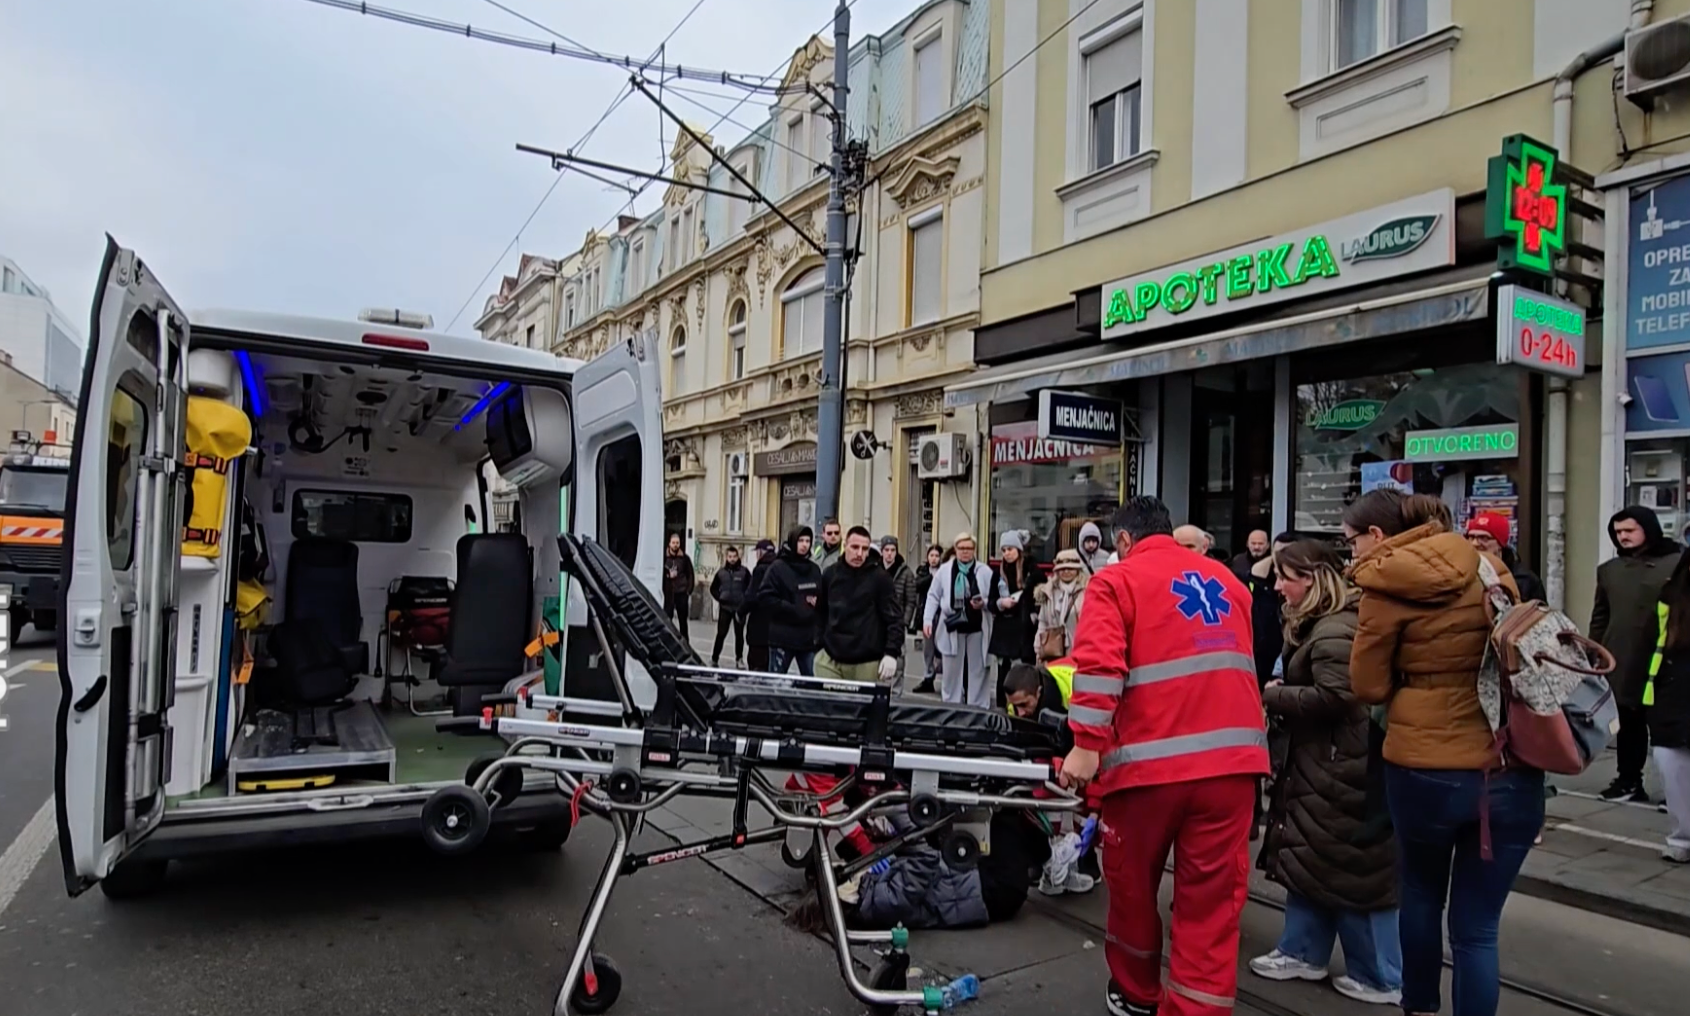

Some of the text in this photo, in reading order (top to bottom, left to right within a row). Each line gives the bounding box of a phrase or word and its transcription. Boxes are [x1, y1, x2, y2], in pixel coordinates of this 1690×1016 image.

[1104, 235, 1340, 328] APOTEKA
[1341, 221, 1425, 260] LAURUS
[1669, 267, 1690, 286] ZA
[1514, 296, 1583, 336] APOTEKA
[1635, 312, 1690, 335] TELEF
[1521, 327, 1576, 367] 0-24h
[1055, 405, 1116, 432] MENJAČNICA
[1305, 405, 1376, 427] LAURUS
[1407, 431, 1516, 456] OTVORENO
[647, 844, 708, 865] SPENCER
